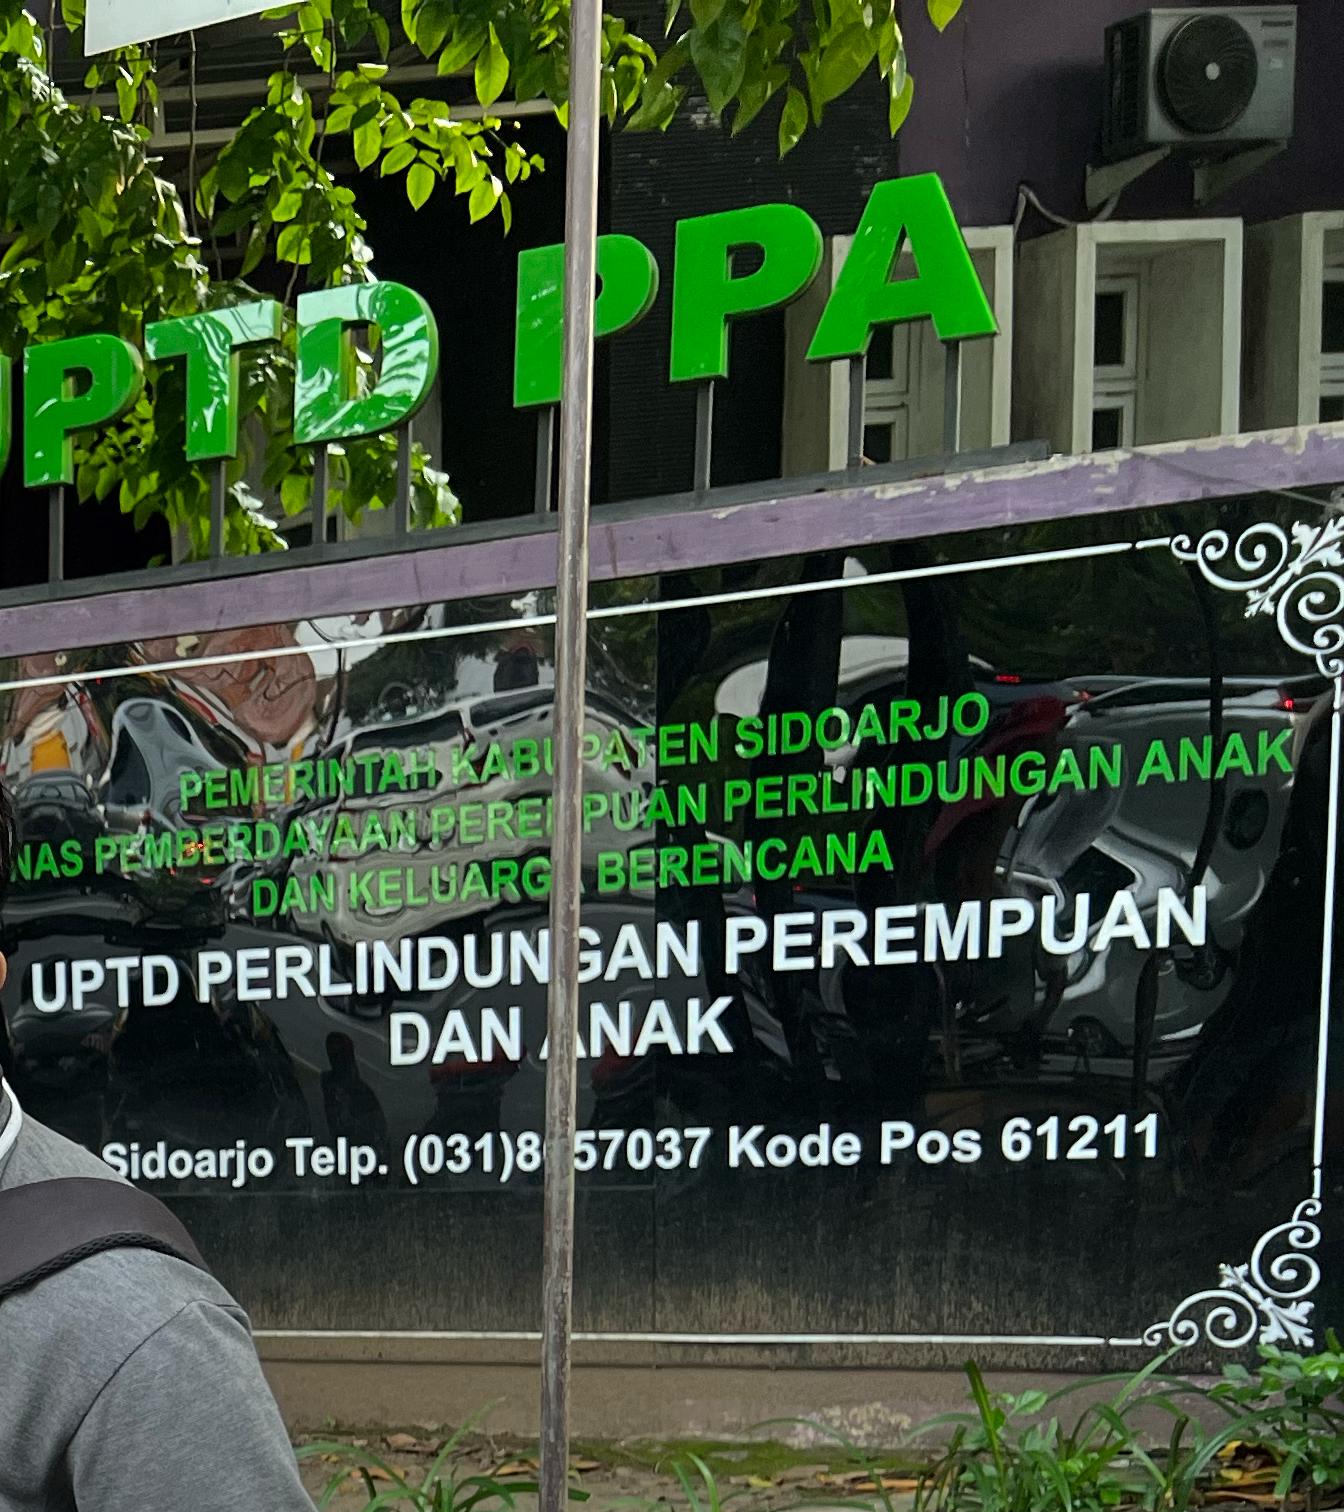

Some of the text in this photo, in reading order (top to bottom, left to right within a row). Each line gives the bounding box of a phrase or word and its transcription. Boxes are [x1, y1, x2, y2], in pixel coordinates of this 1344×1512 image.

[514, 172, 999, 408] PPA
[10, 727, 1294, 883] NAS PEMBERDAYAAN PEREPUAN PERLINDUNGAN ANAK
[179, 751, 439, 812] PEMERINTAH
[735, 692, 990, 761] SIDOARJO
[252, 831, 894, 918] DAN KELUARG BERENCANA
[31, 884, 1208, 1014] UPTD PERLINDUNGAN PEREMPUAN
[389, 1006, 521, 1066] DAN
[101, 1113, 1158, 1187] Sidoarjo Telp. (031)857037 Kode Pos 61211
